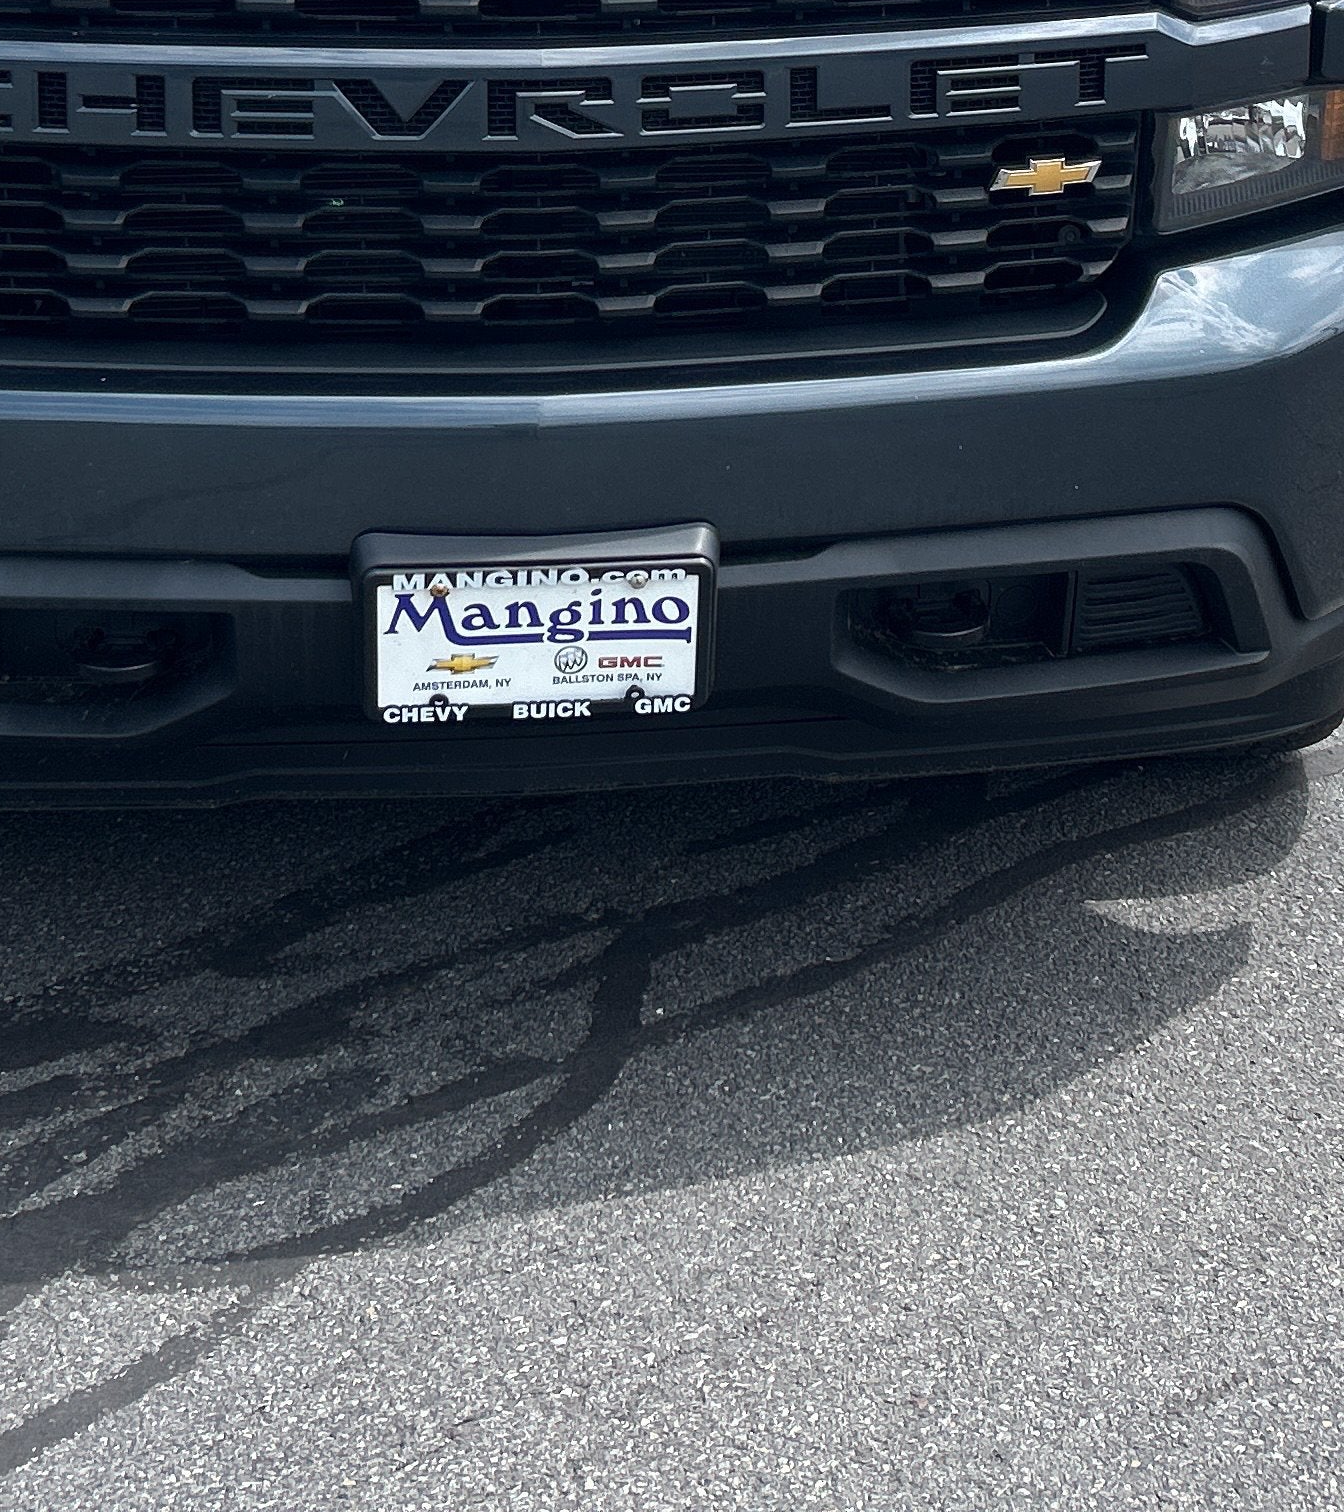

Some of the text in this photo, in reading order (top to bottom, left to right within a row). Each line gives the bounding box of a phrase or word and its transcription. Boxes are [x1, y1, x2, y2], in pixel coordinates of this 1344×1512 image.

[392, 567, 687, 591] MANGINO.com
[383, 588, 692, 646] Mangino
[598, 655, 665, 669] GMC
[412, 678, 512, 692] AMSTERDAM, NY
[552, 672, 663, 685] BALLSTON SPA, NY
[383, 696, 691, 724] CHEVY BUICK GMC
